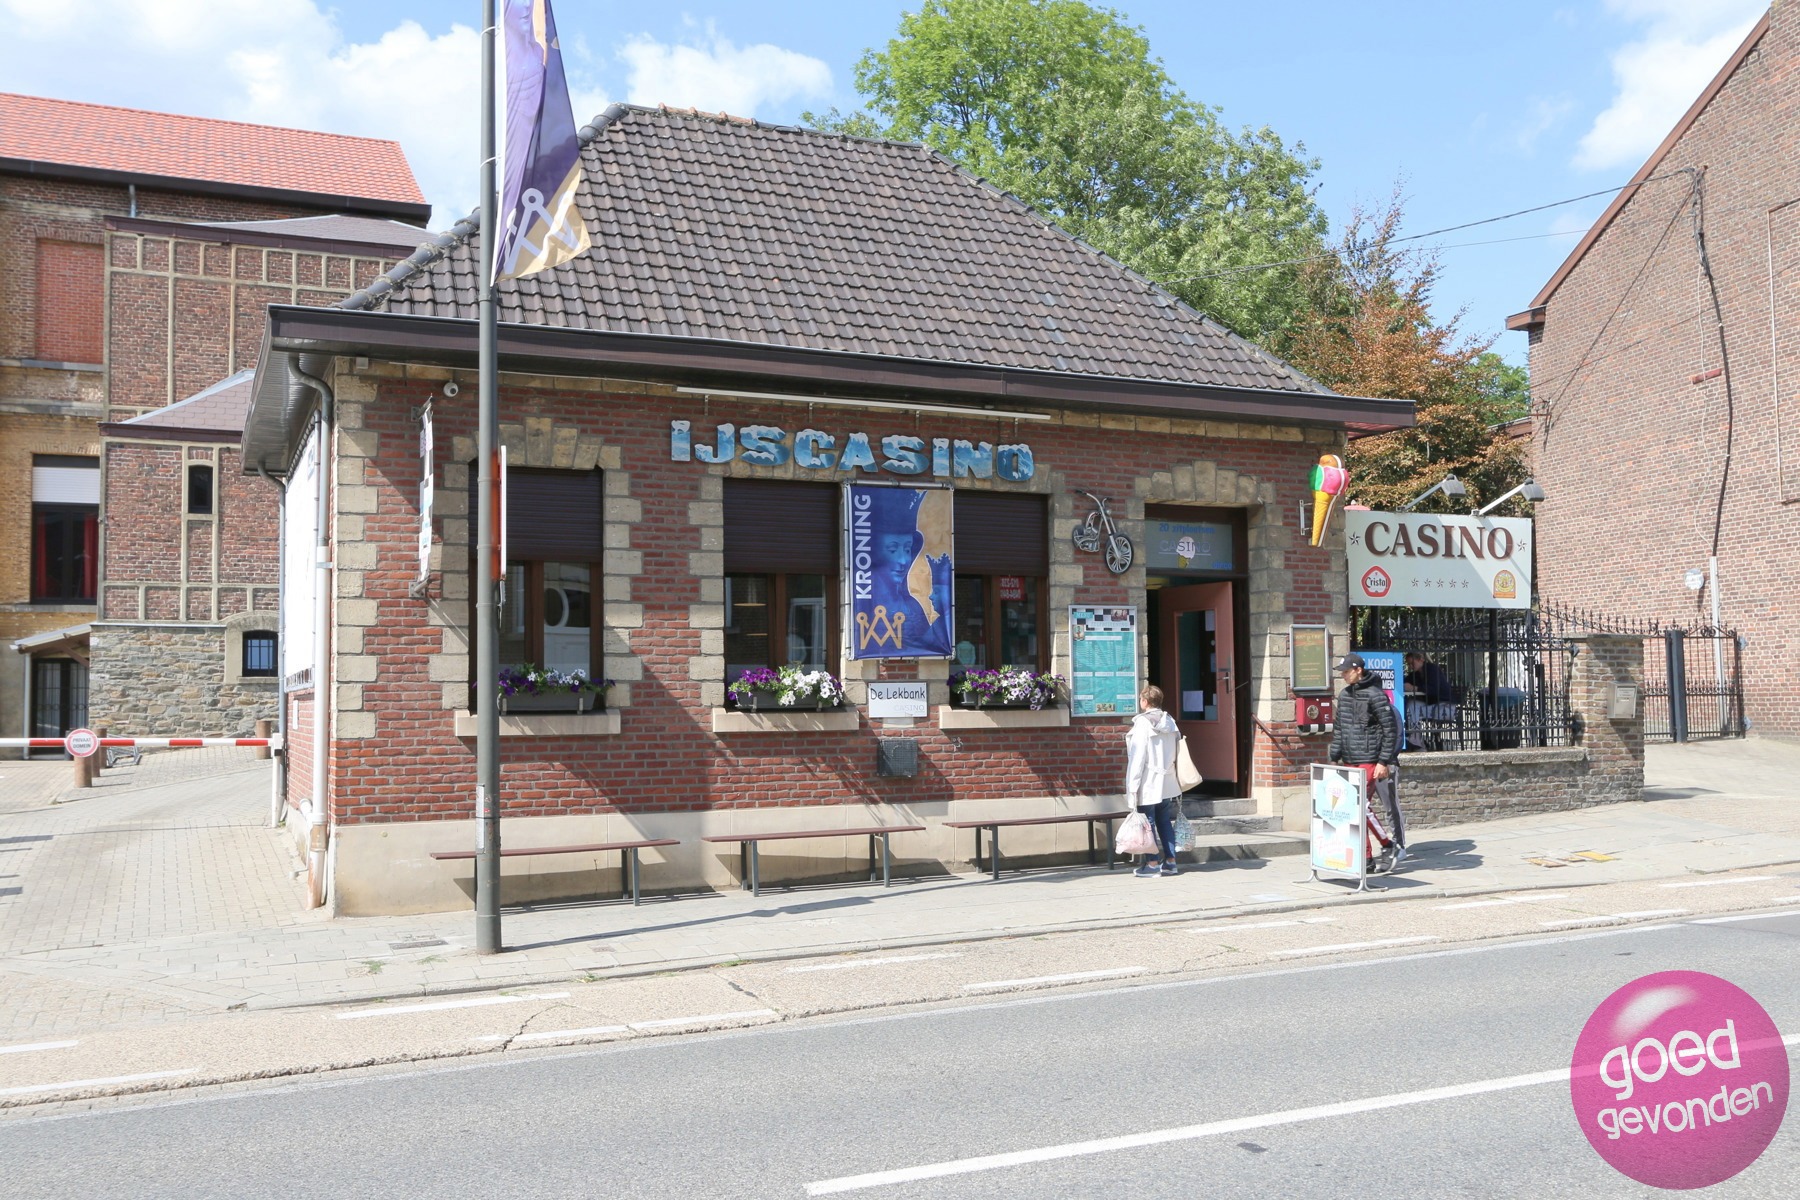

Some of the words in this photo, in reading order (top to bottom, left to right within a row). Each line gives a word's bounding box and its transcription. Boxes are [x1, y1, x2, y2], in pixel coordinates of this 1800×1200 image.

[671, 420, 1034, 481] IJSCASINO
[854, 494, 872, 599] KRONING
[1160, 540, 1211, 553] CASINO
[1364, 521, 1514, 559] CASINO
[1367, 658, 1393, 669] KOOP
[870, 688, 883, 700] De
[886, 687, 926, 700] Lekbank
